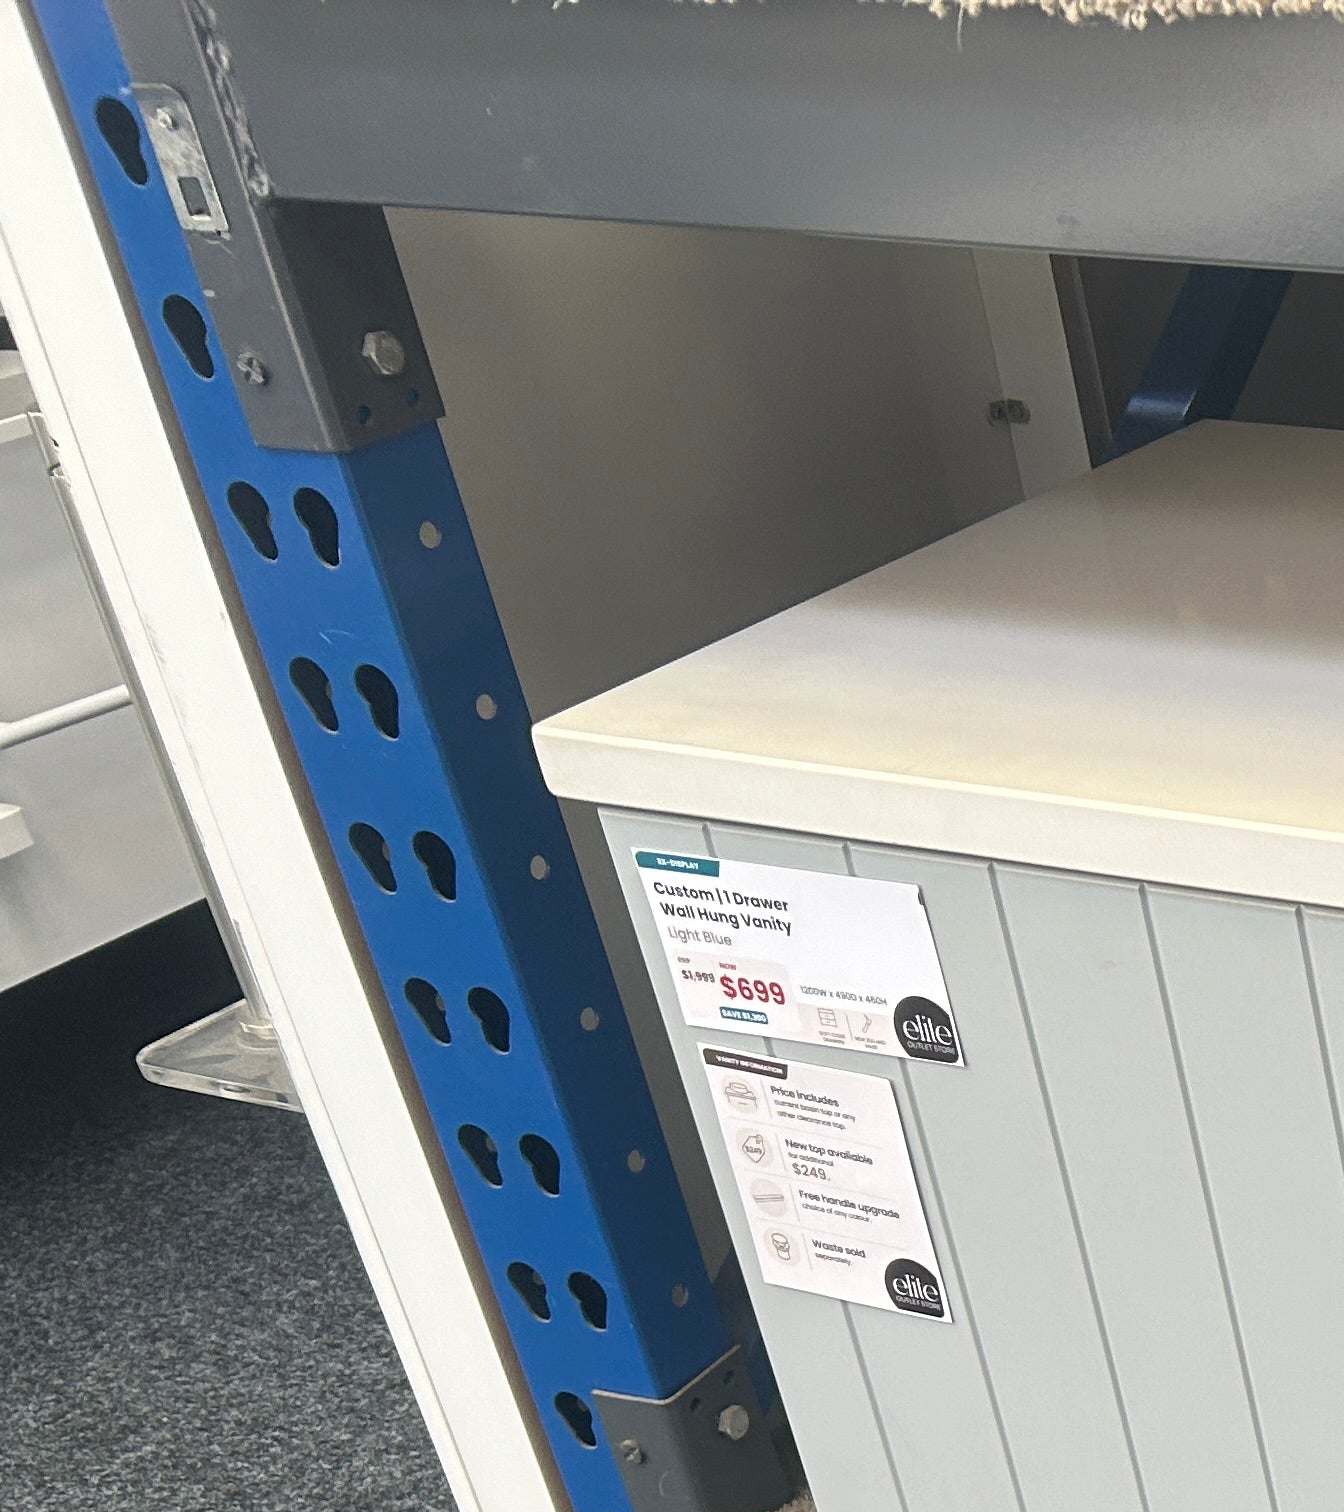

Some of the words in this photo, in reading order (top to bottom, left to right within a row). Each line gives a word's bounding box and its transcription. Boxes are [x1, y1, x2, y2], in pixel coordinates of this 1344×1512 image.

[653, 881, 715, 902] Custom
[724, 890, 731, 904] 1
[733, 891, 789, 912] Drawer
[659, 901, 696, 919] Wall
[697, 907, 740, 929] Hung
[740, 913, 792, 936] Vanity
[667, 926, 700, 944] Light
[703, 930, 732, 946] Blue
[719, 974, 786, 1005] $699
[903, 1014, 953, 1045] elite
[907, 1041, 933, 1052] OUTLET
[933, 1044, 955, 1055] STORE
[770, 1085, 796, 1099] Price
[784, 1138, 807, 1151] New
[808, 1143, 825, 1156] top
[826, 1148, 873, 1166] available
[798, 1189, 821, 1202] Free
[821, 1193, 857, 1210] handle
[857, 1203, 900, 1219] upgrade
[811, 1238, 844, 1254] Waste
[844, 1247, 867, 1259] sold
[892, 1273, 939, 1302] elite
